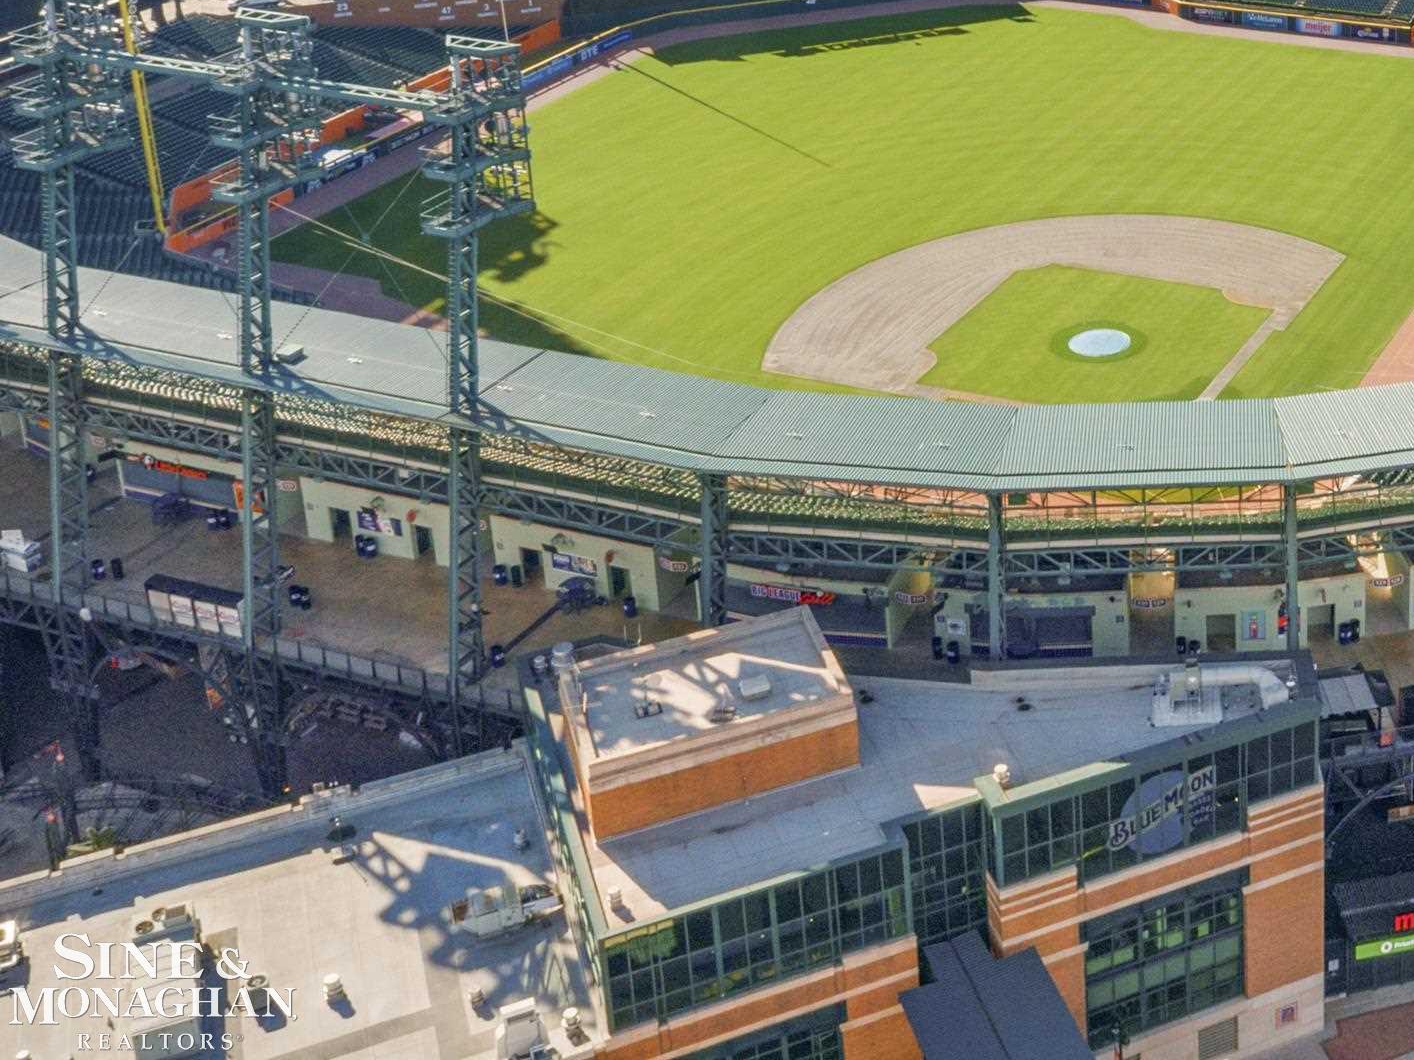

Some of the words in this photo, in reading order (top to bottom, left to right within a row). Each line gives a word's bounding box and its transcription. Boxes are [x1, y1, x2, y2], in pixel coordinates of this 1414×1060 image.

[581, 45, 599, 61] DTE
[1111, 807, 1161, 847] BLUE
[1163, 769, 1214, 814] MON
